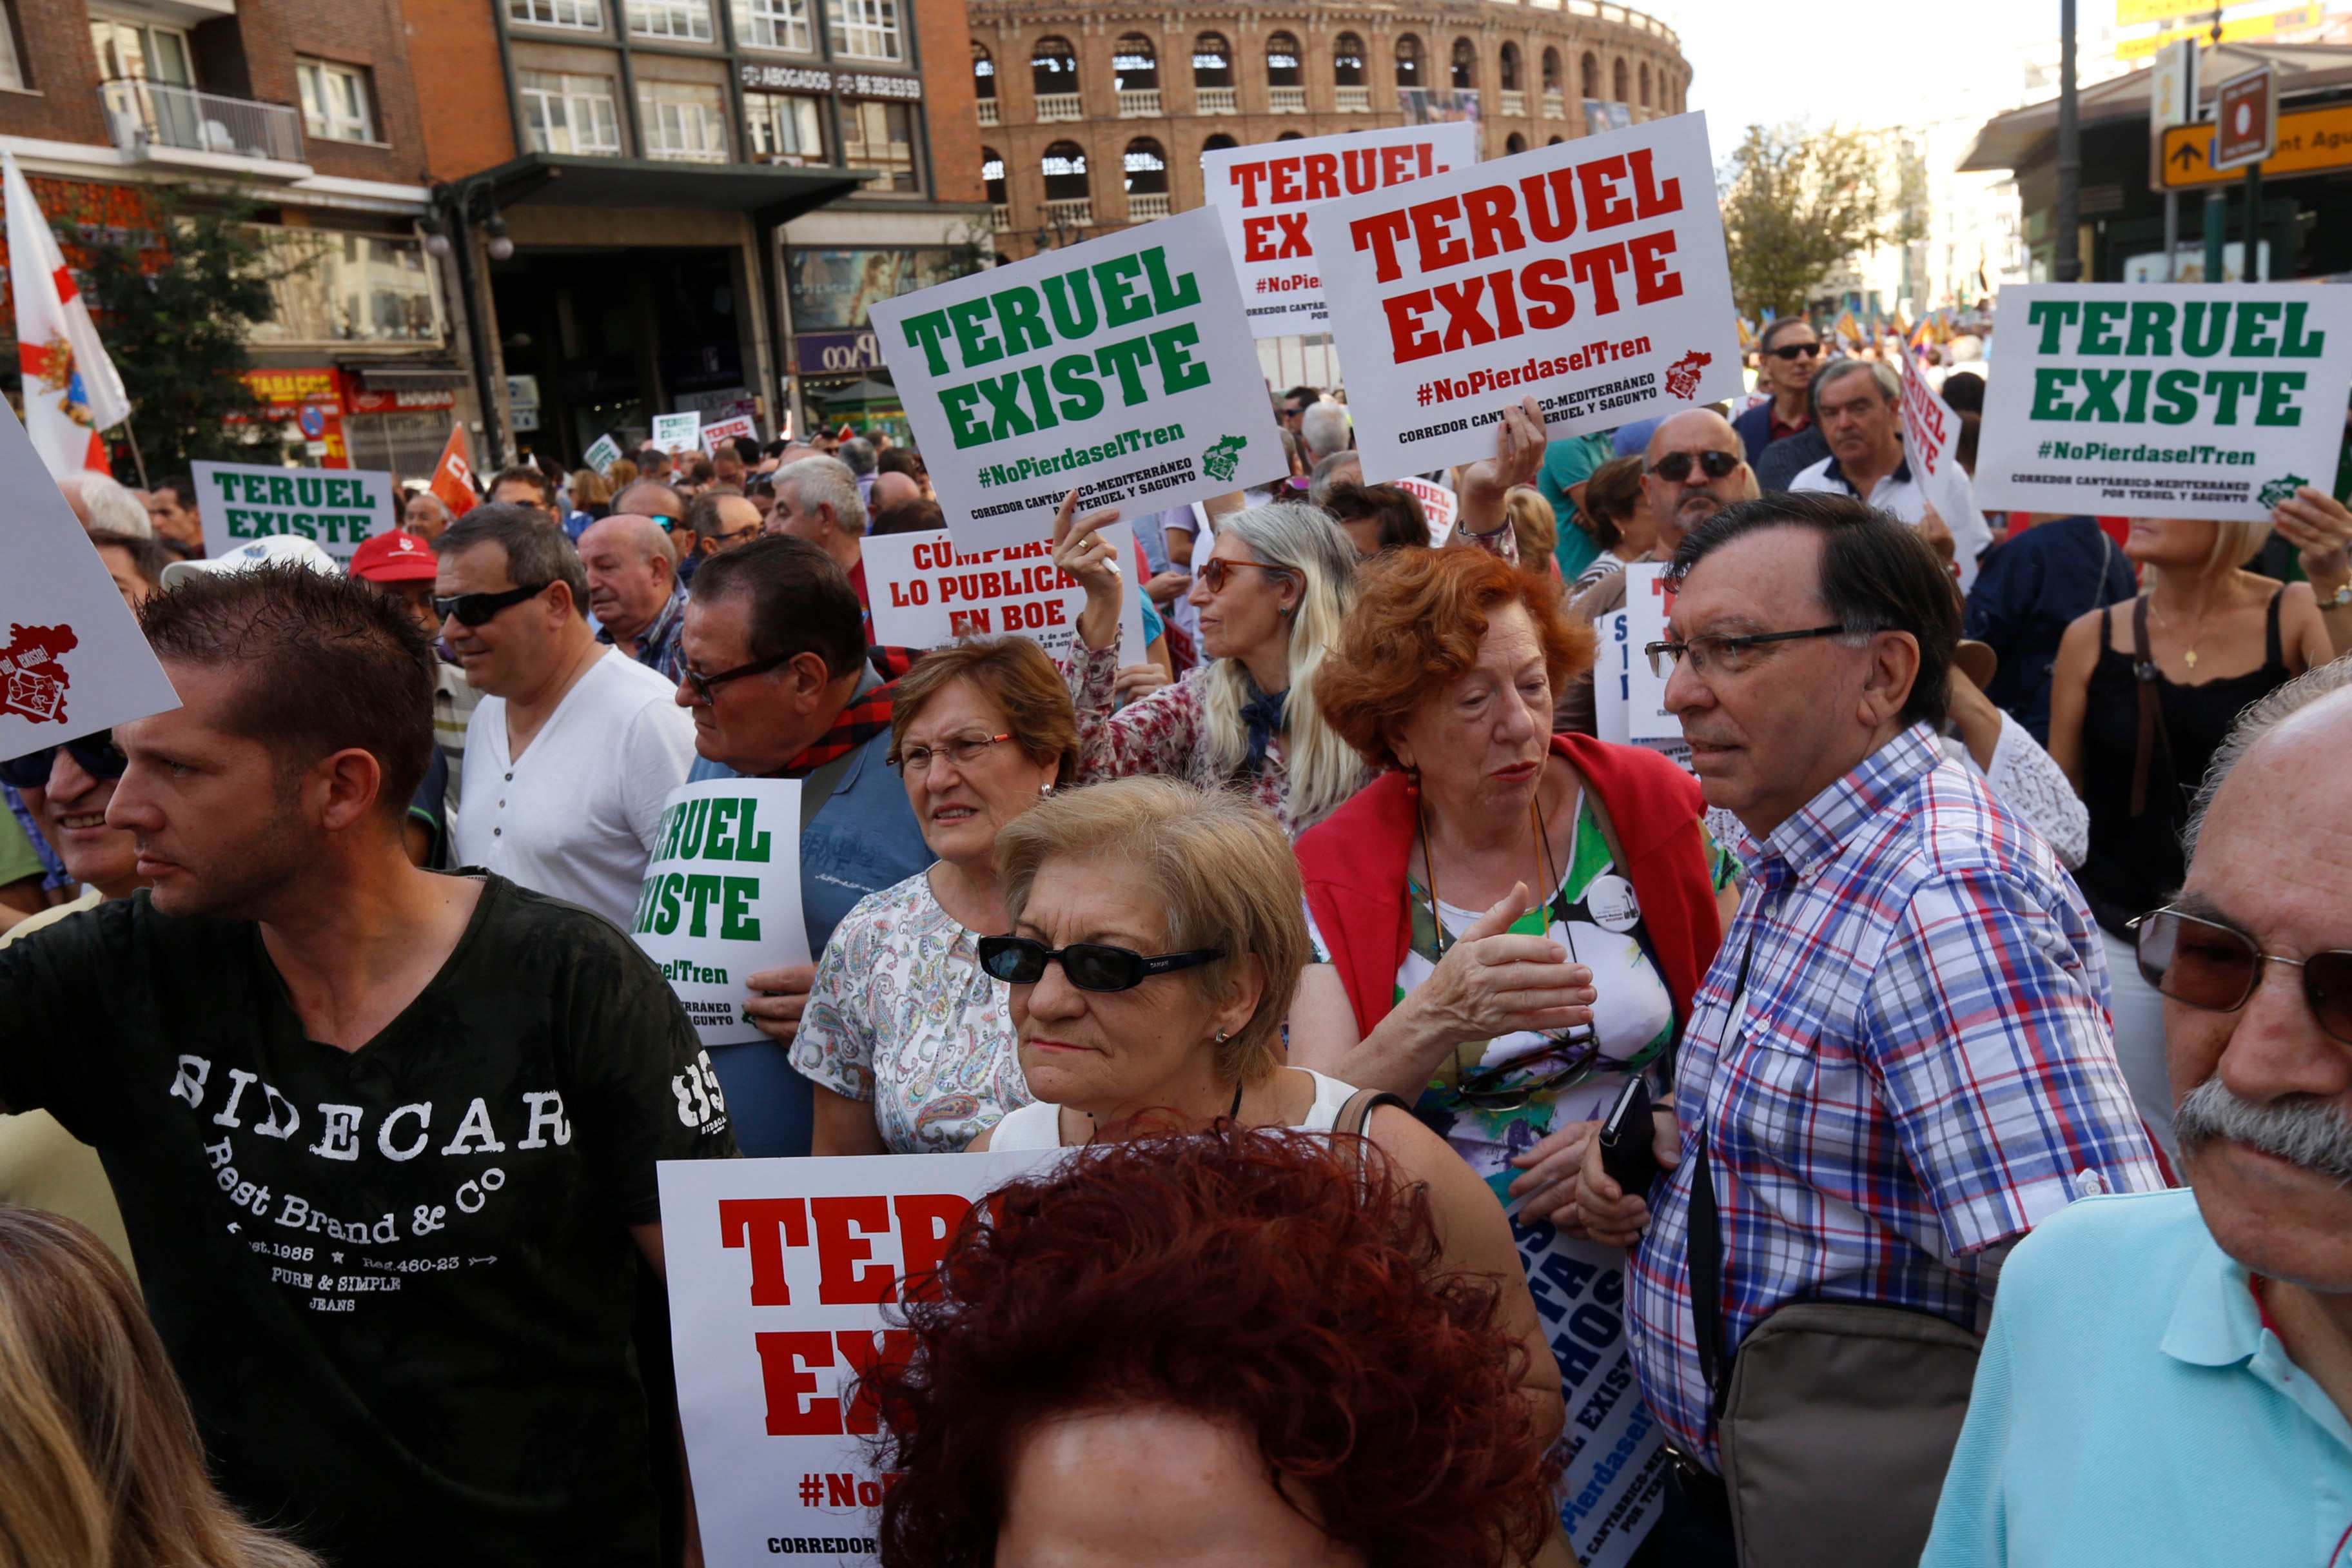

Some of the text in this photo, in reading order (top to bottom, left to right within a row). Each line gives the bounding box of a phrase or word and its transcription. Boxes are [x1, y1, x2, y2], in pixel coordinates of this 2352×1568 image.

[762, 66, 832, 90] ABOGADOS
[1349, 148, 1683, 283] TERUEL
[901, 246, 1201, 377] TERUEL
[1246, 305, 1287, 317] ORREDOR
[1382, 230, 1683, 364] EXISTE
[2028, 301, 2325, 358] TERUEL
[937, 322, 1211, 449] EXISTE
[1417, 336, 1651, 407] #NoPierdaselTren
[1544, 387, 1658, 424] ERUEL Y SAGUNTO
[2030, 368, 2307, 427] EXISTE
[1399, 418, 1468, 444] CORREDOR
[978, 423, 1185, 488] #NoPierdaselTren
[2037, 441, 2256, 466] #NoPierdaselTren
[213, 473, 375, 509] TERUEL
[1077, 492, 1125, 511] TERUEL
[1128, 486, 1135, 498] Y
[1140, 471, 1196, 495] SAGUNTO
[2012, 473, 2073, 485] CORREDOR
[2076, 475, 2250, 491] CANTÁBRICO-MEDITERRÁNEO
[2102, 489, 2249, 503] POR TERUEL Y SAGUNTO
[226, 509, 372, 543] EXISTE
[970, 502, 1024, 520] CORREDOR
[889, 565, 1083, 607] LO PUBLICA
[949, 599, 1066, 637] EN BOE
[17, 644, 51, 669] existe!
[170, 1054, 571, 1161] SIDECAR
[701, 1116, 727, 1134] SIDECA
[204, 1136, 505, 1245] Best Brand & Co
[271, 1267, 403, 1293] PURE & SIMPLE
[364, 1257, 462, 1273] Reg.460-23
[309, 1298, 357, 1313] JEANS
[768, 1538, 876, 1554] CORREDOR
